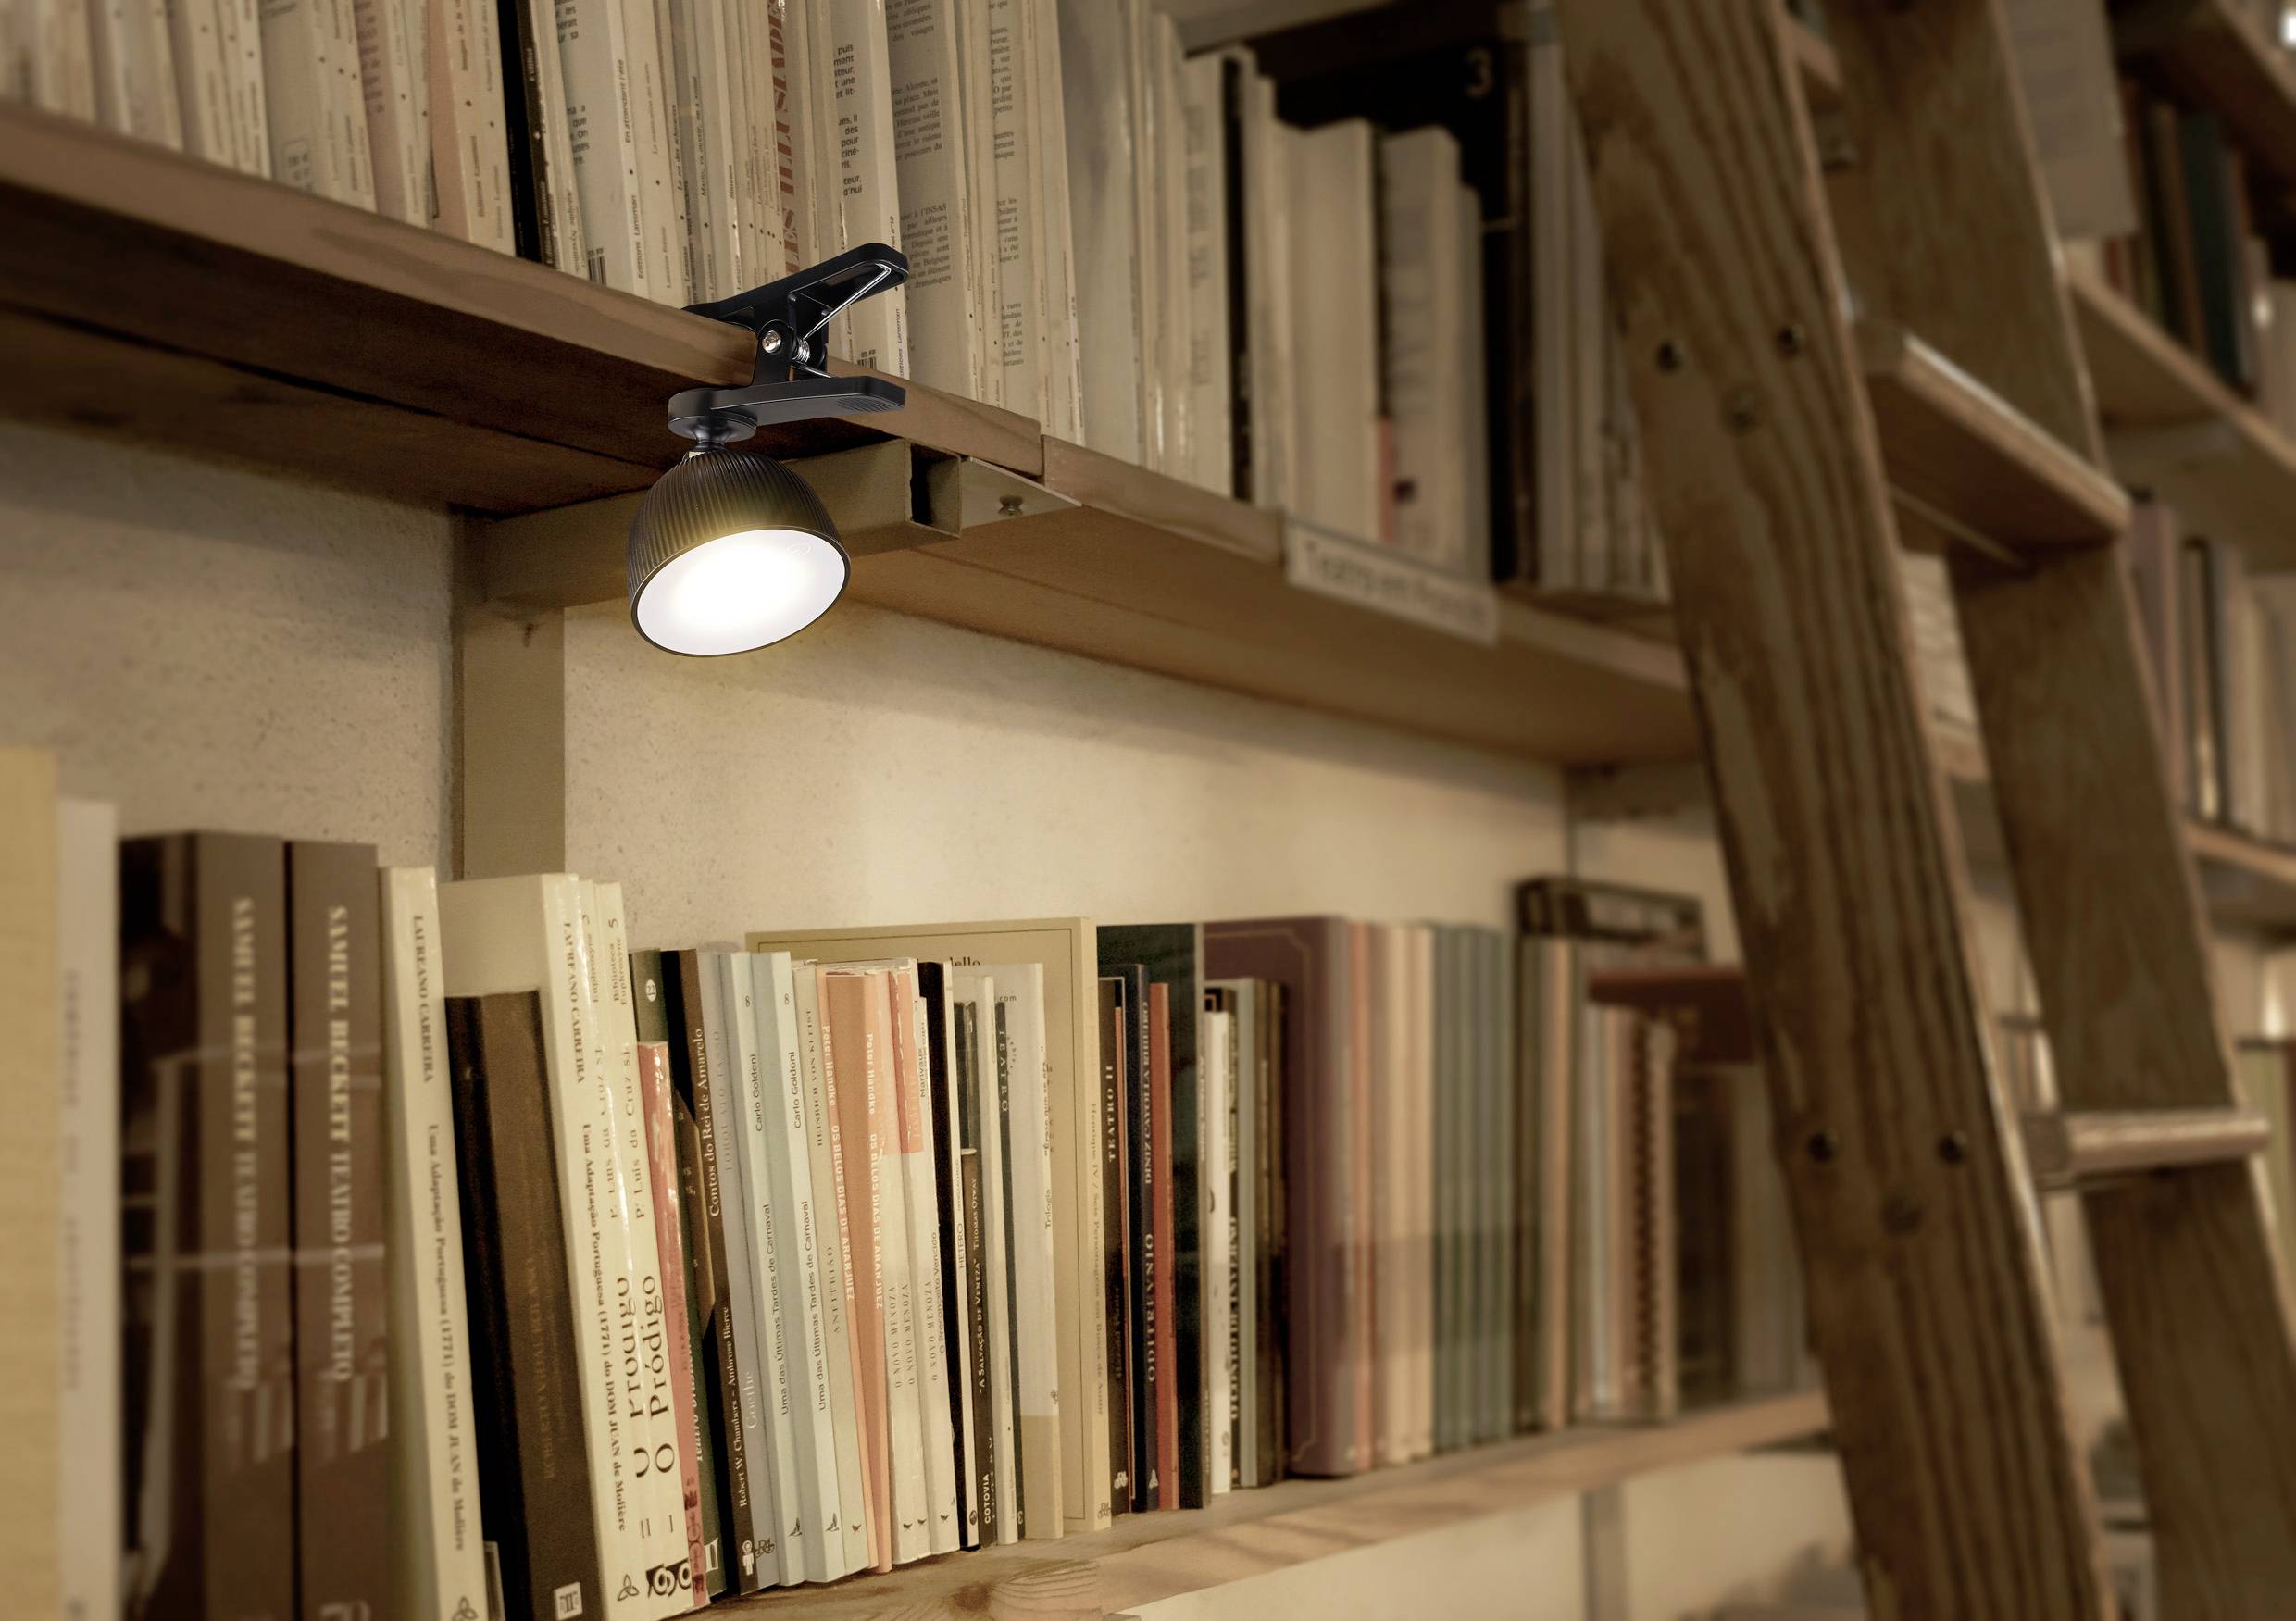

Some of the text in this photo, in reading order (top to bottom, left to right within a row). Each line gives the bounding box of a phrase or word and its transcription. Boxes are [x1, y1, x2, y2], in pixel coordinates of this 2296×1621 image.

[838, 44, 853, 55] puis
[841, 77, 855, 87] une
[841, 137, 859, 148] pour
[844, 126, 858, 135] des
[631, 195, 640, 235] Lansman
[608, 917, 618, 929] 5
[329, 906, 349, 1011] SAMUEL
[609, 942, 619, 1002] Biblioteca
[413, 916, 434, 1083] LAUREANO CARREIRA
[563, 922, 585, 1083] LAUREANO CARREIRA
[822, 1024, 831, 1055] Peter
[330, 1019, 350, 1142] BECKETT
[750, 1054, 762, 1098] Goldoni
[788, 1051, 800, 1095] Goldoni
[806, 1009, 822, 1147] HEINRICH VON KLEIST
[826, 1059, 836, 1107] Handke
[917, 1048, 926, 1098] Marivaux
[998, 1028, 1009, 1112] TEATRO
[1142, 1002, 1153, 1184] DINIZ CAYOLLA RIBEIRO
[624, 1079, 634, 1116] Cruz
[693, 1028, 720, 1217] Contos do Rei de Amarelo
[582, 1123, 591, 1154] Uma
[630, 1128, 638, 1149] da
[1107, 1089, 1116, 1162] TEATRO
[833, 1143, 844, 1184] BELOS
[867, 1067, 875, 1115] Handke
[874, 1245, 883, 1310] ARANJUEZ
[331, 1152, 351, 1242] TEATRO
[430, 1160, 444, 1232] Adaptação
[584, 1159, 598, 1228] Adaptação
[837, 1185, 847, 1215] DIAS
[435, 1237, 447, 1316] Portuguesa
[592, 1231, 605, 1306] Portuguesa
[842, 1236, 855, 1301] ARANJUEZ
[931, 1231, 942, 1275] Vencido
[723, 1306, 732, 1340] Bierce
[763, 1203, 789, 1415] Uma das Últimas Tardes de Carnaval
[801, 1201, 826, 1411] Uma das Últimas Tardes de Carnaval
[888, 1286, 898, 1336] MENOZA
[902, 1283, 911, 1333] MENOZA
[925, 1280, 936, 1331] MENOZA
[935, 1276, 944, 1342] Preconceito
[598, 1310, 612, 1356] (1771)
[905, 1339, 914, 1373] NOVO
[928, 1335, 936, 1370] NOVO
[643, 1275, 675, 1474] O Pródigo
[724, 1342, 736, 1387] Ambrose
[890, 1342, 900, 1378] NOVO
[446, 1392, 459, 1431] DOM
[605, 1379, 618, 1415] DOM
[742, 1371, 757, 1429] Goethe
[609, 1416, 621, 1456] JUAN
[730, 1398, 742, 1452] Chambers
[614, 1479, 627, 1531] Molière
[738, 1473, 748, 1508] Robert
